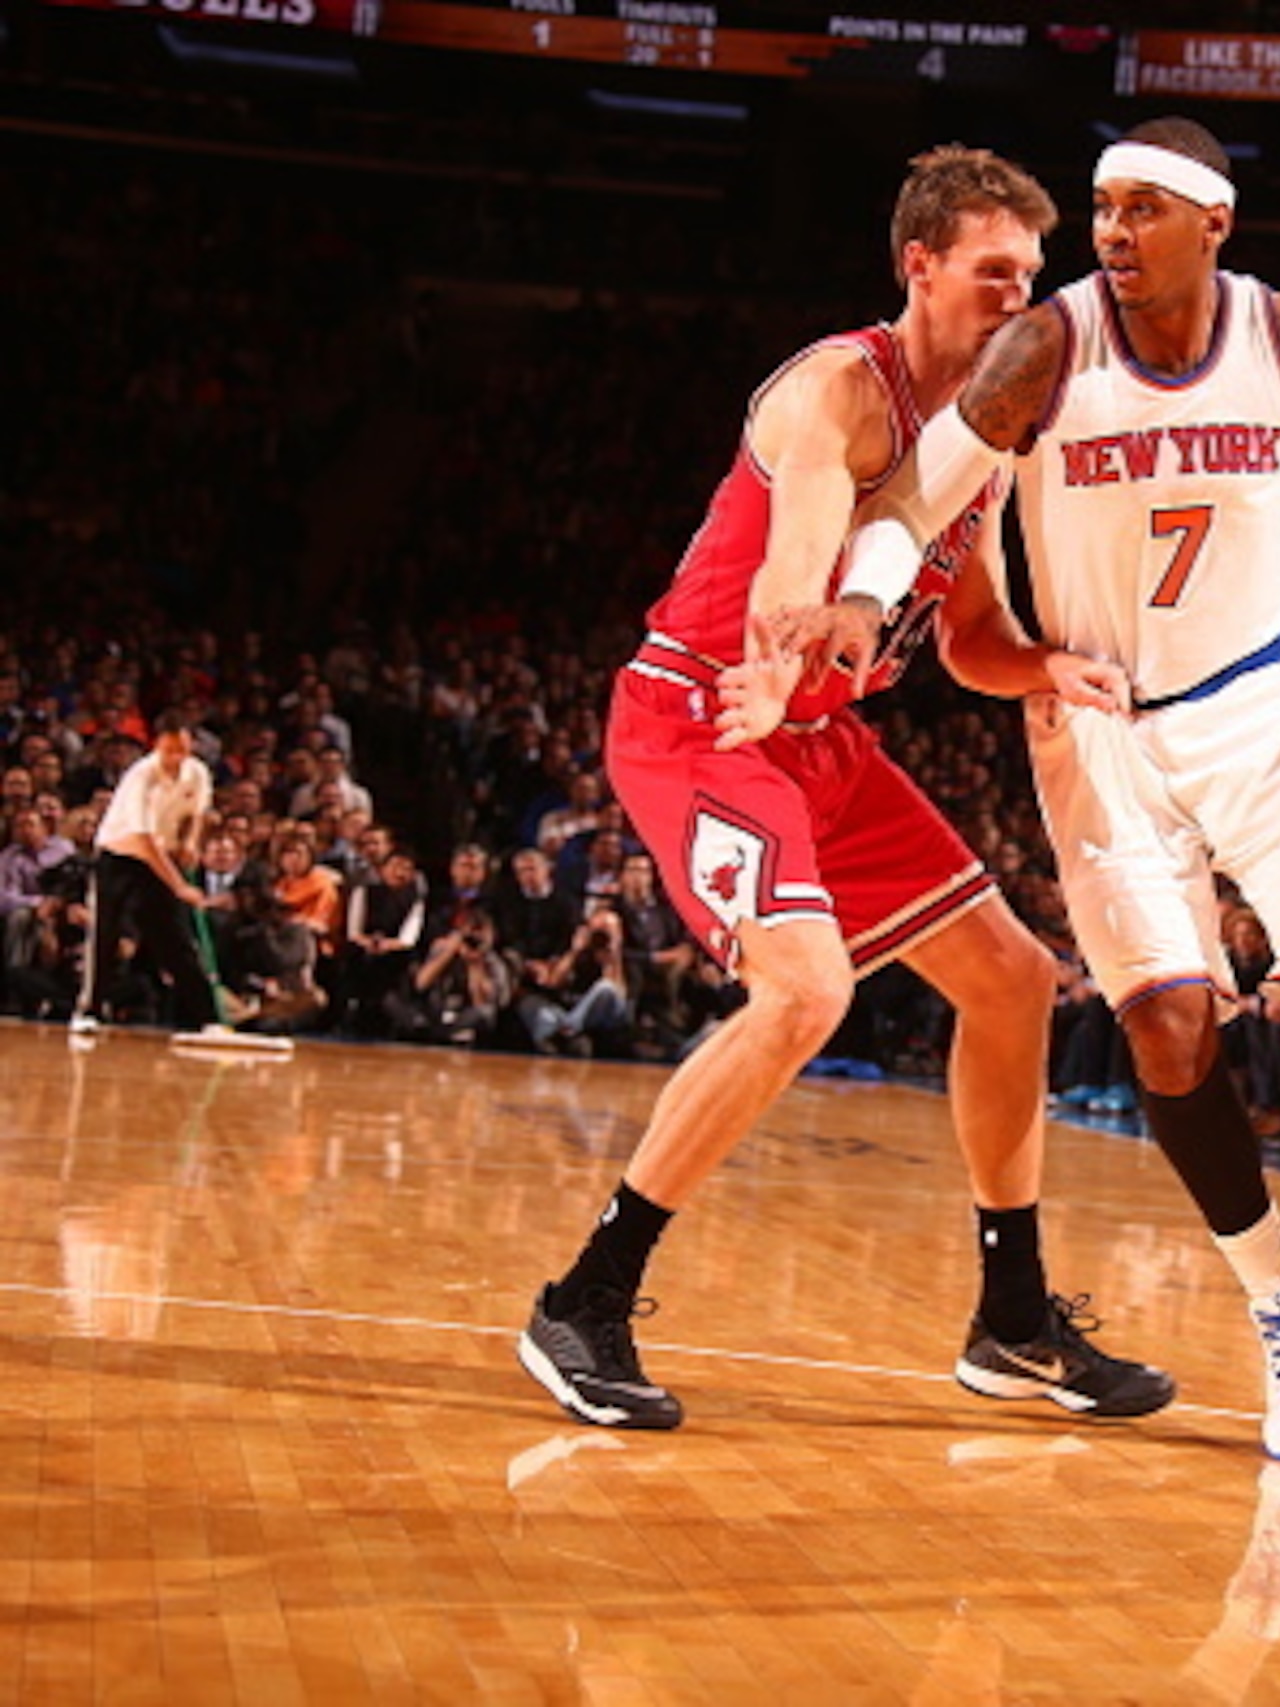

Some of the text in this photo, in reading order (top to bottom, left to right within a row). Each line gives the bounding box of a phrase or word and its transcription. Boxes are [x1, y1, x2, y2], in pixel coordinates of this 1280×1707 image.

[533, 20, 550, 48] 1
[625, 23, 674, 45] FULL
[829, 15, 1027, 46] POINTS IN THE PAINT
[917, 47, 946, 80] 4
[1184, 38, 1241, 67] LIKE
[1061, 428, 1164, 486] NEW
[1148, 504, 1215, 608] 7
